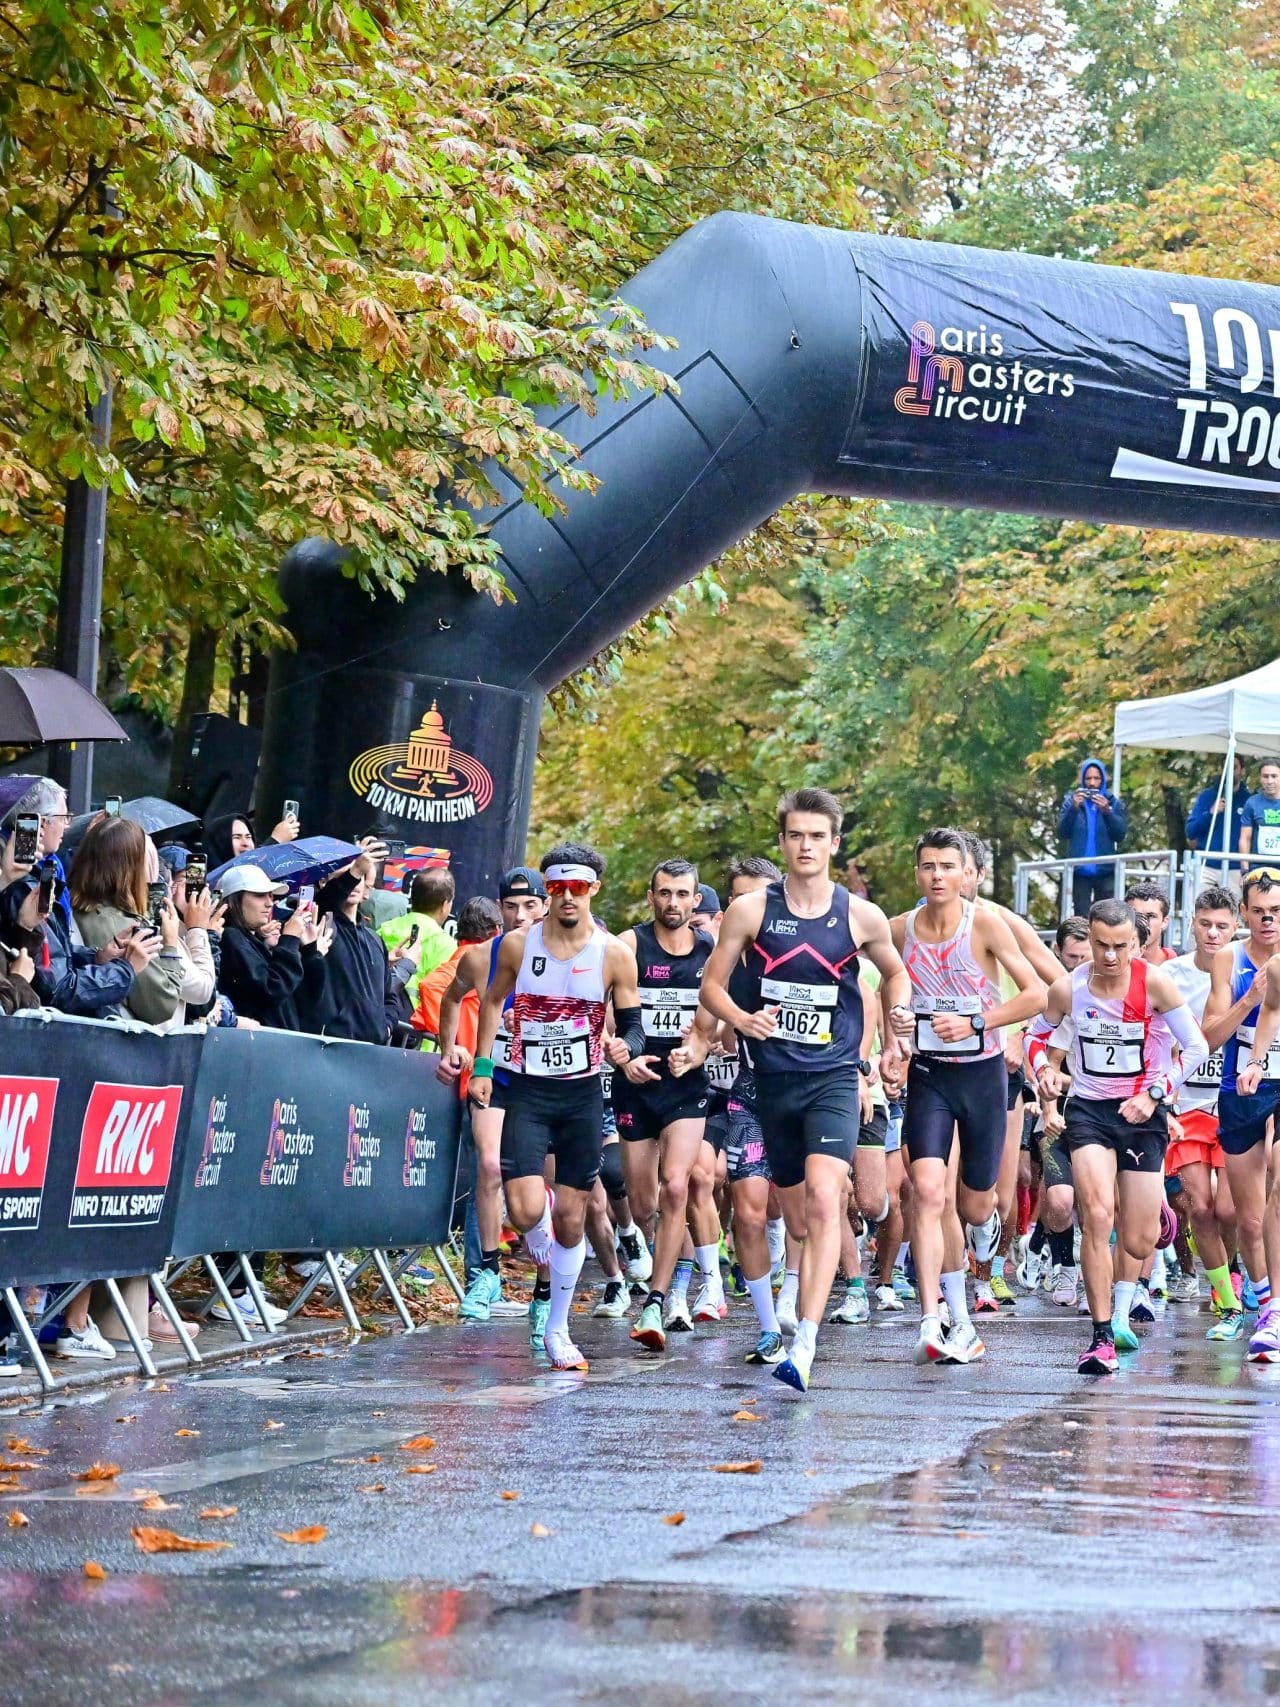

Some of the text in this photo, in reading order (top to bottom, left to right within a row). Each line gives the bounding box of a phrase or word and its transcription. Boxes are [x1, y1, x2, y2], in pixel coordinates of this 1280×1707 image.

[366, 783, 475, 822] 10 KM PANTHEON
[652, 1012, 681, 1030] 444
[775, 1011, 820, 1035] 4062
[542, 1046, 573, 1067] 455
[1106, 1046, 1116, 1065] 2
[707, 1063, 735, 1080] 5171
[1197, 1059, 1224, 1077] 063
[0, 1092, 38, 1176] MC
[95, 1100, 165, 1175] RMC
[2, 1197, 40, 1219] SPORT
[73, 1194, 165, 1216] INFO TALK SPORT
